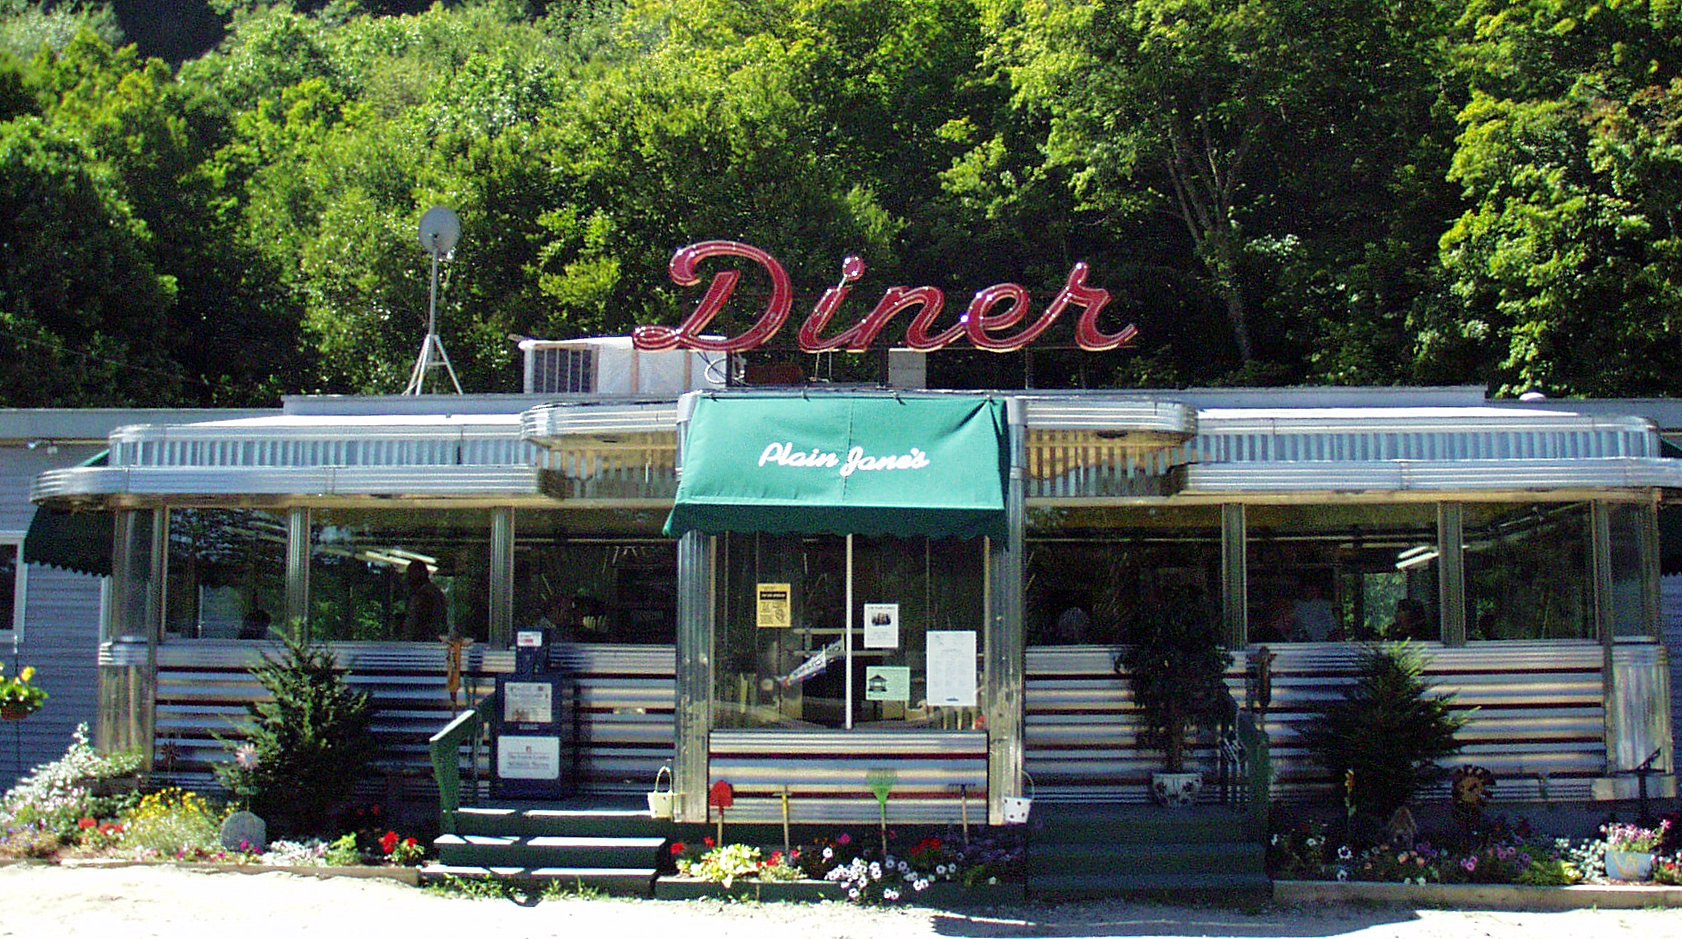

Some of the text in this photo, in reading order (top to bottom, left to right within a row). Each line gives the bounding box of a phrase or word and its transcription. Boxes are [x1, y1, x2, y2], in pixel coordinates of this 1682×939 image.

[632, 240, 1138, 353] Diner
[758, 442, 930, 477] Plain Jane's
